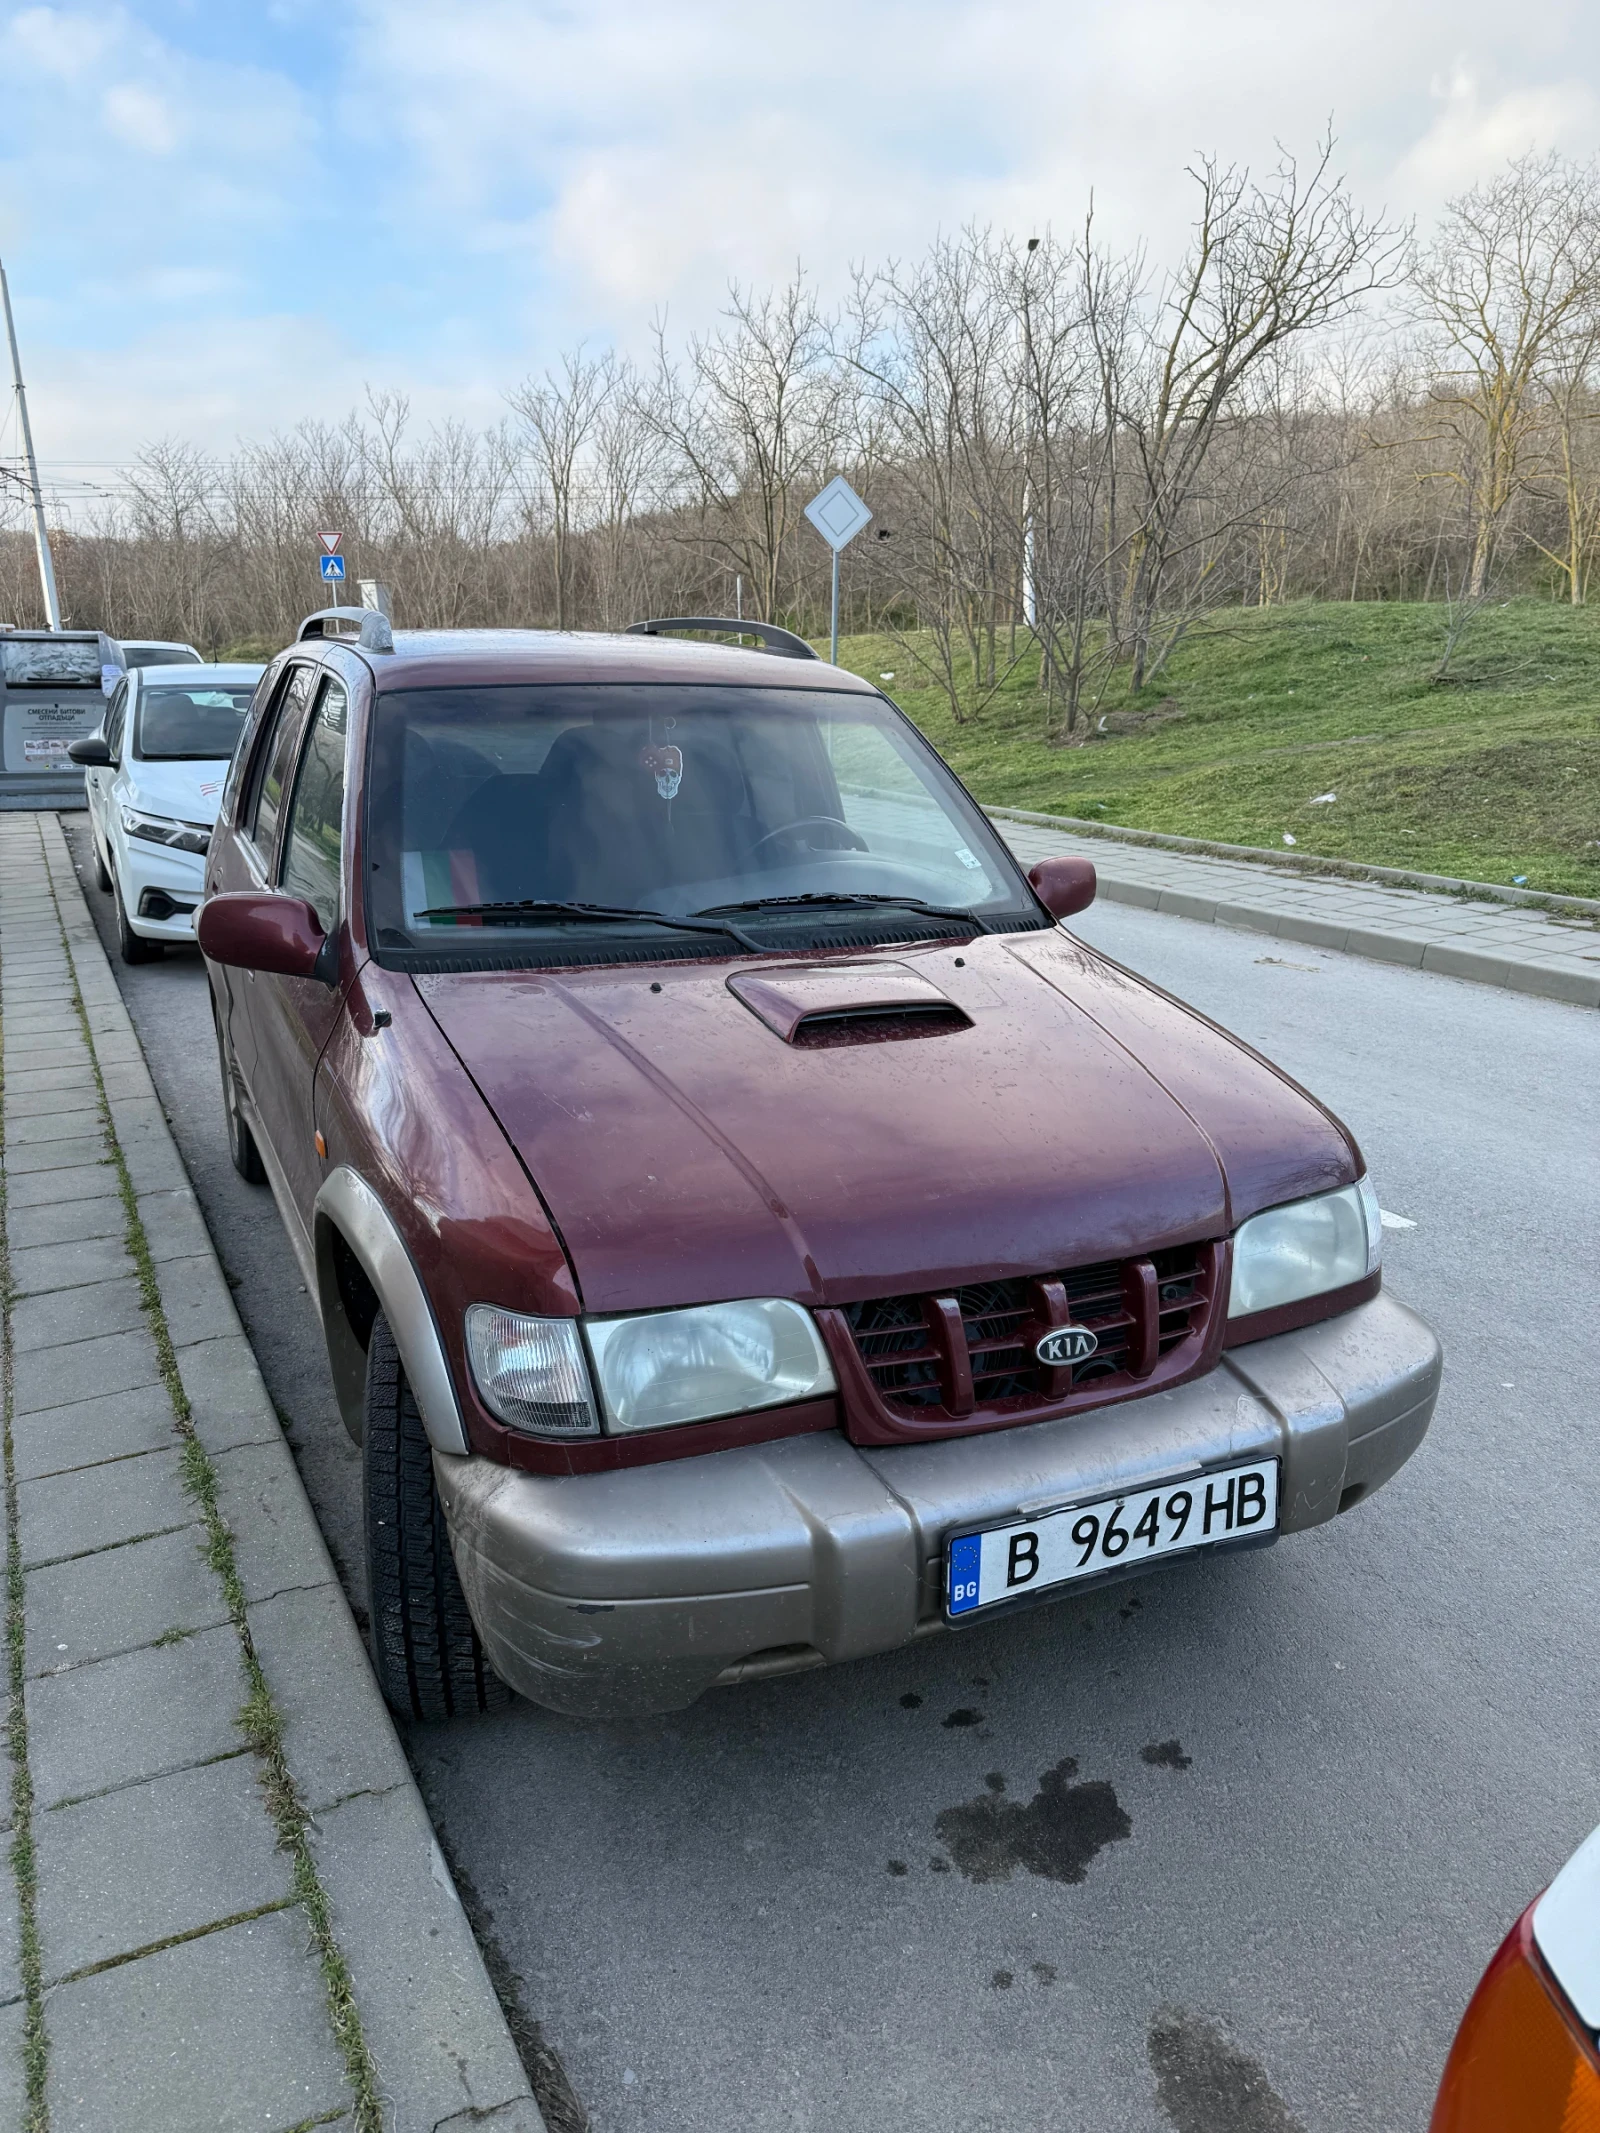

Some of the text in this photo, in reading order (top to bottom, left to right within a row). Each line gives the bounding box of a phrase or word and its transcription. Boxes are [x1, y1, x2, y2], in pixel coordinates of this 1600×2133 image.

[1047, 1335, 1090, 1360] KIA
[1006, 1531, 1040, 1588] B
[954, 1581, 977, 1602] BG
